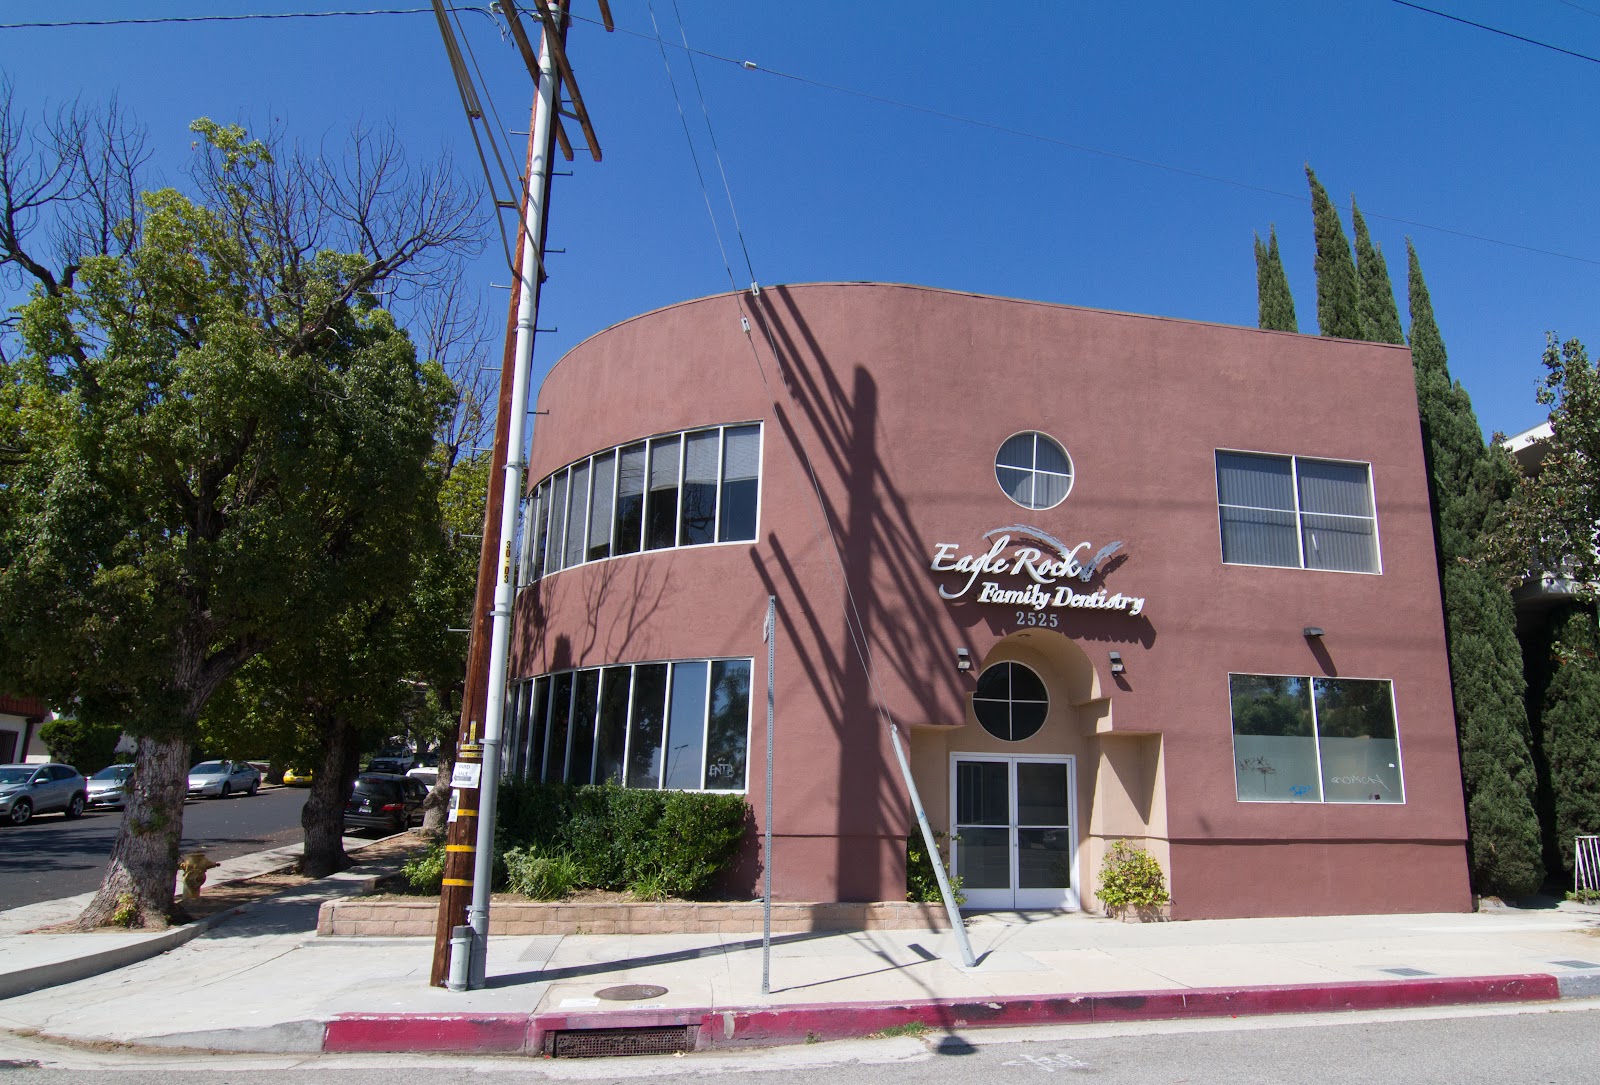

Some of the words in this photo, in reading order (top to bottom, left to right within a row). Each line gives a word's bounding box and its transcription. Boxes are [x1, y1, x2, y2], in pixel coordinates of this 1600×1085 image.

[503, 541, 511, 583] 30-03
[931, 535, 1010, 599] Eagle
[1011, 541, 1091, 584] Rock
[977, 582, 1051, 610] Family
[1052, 586, 1145, 616] Dentistry
[1016, 611, 1058, 627] 2525
